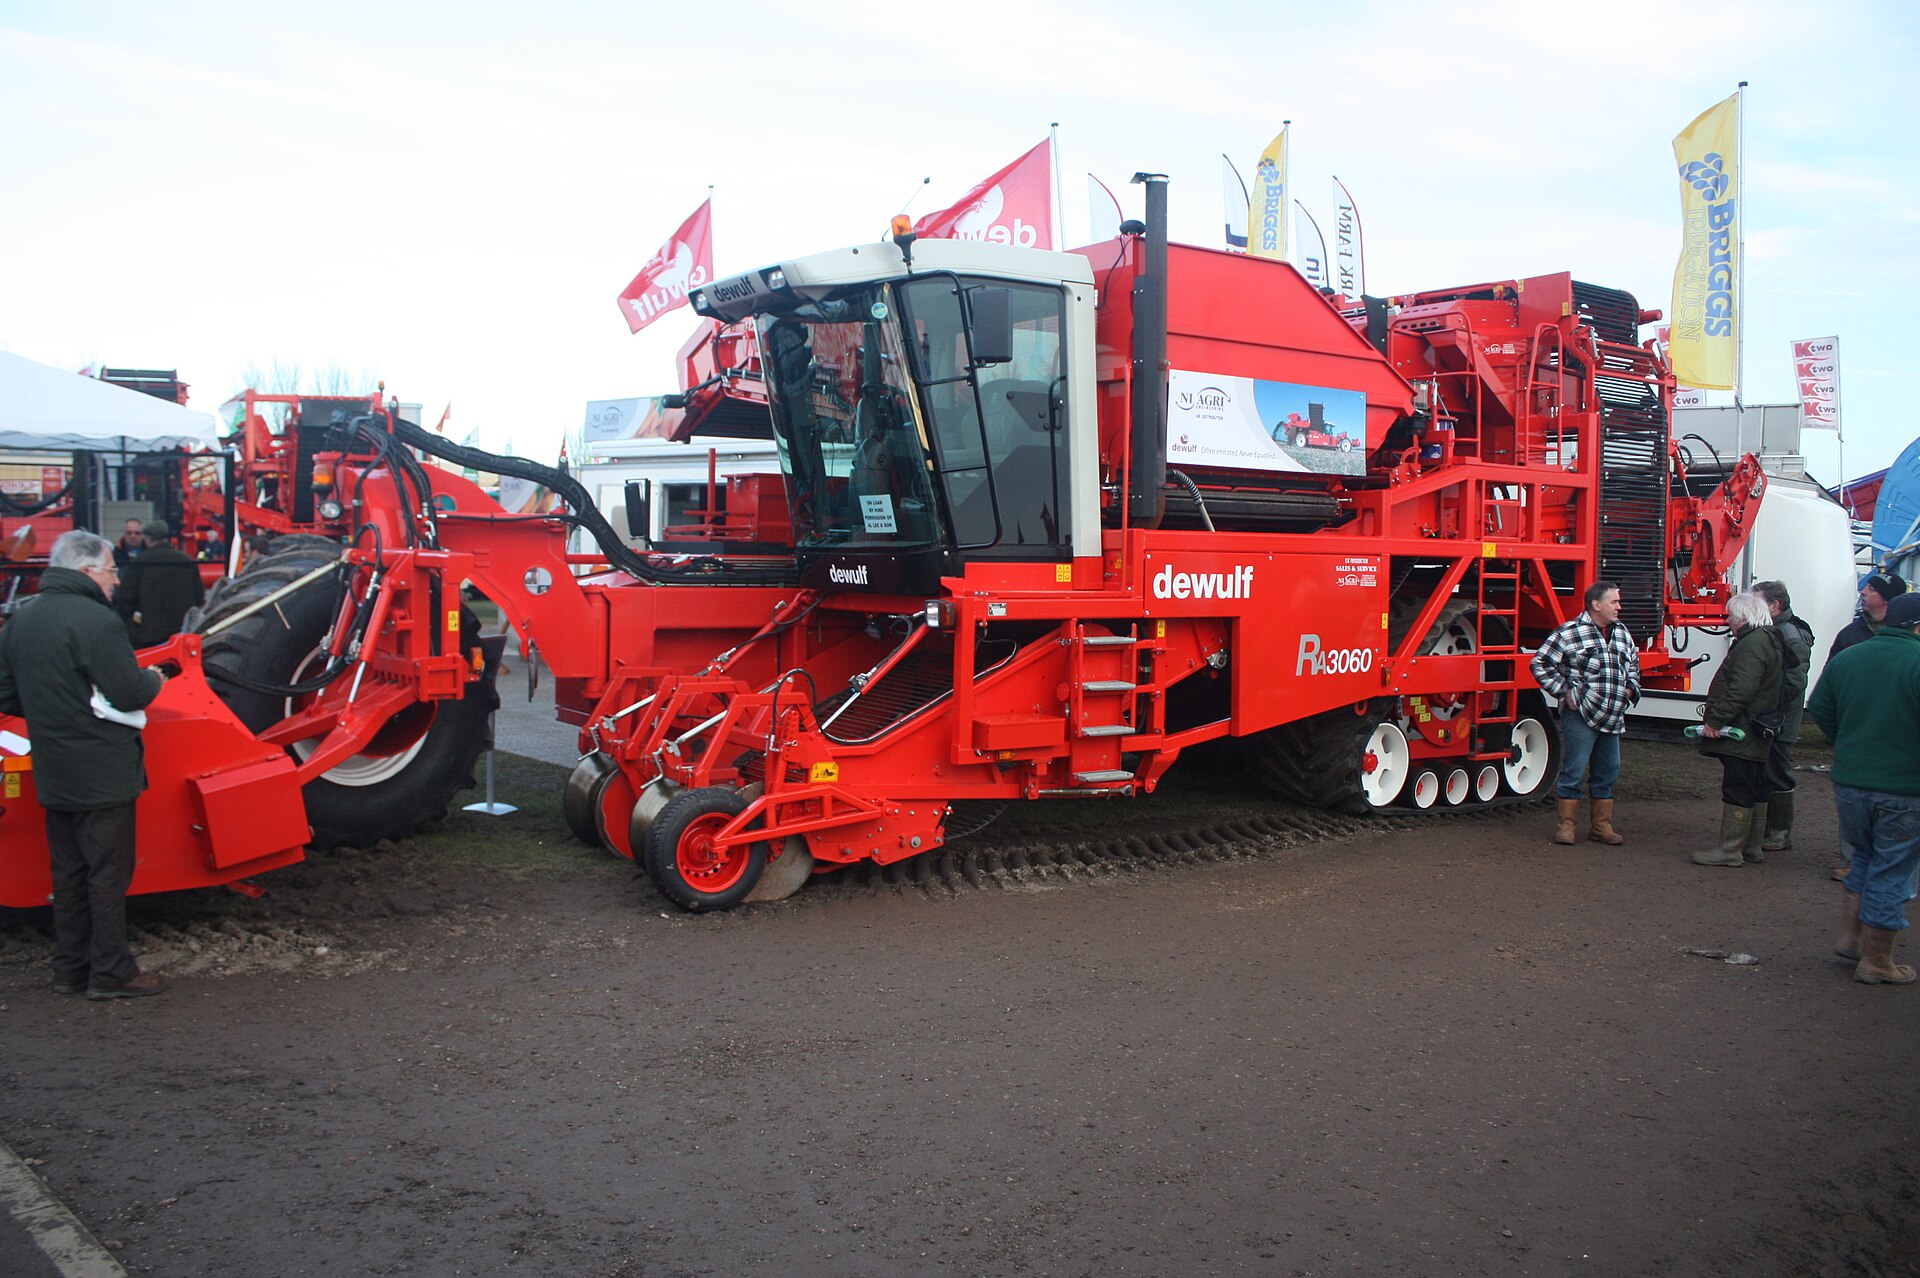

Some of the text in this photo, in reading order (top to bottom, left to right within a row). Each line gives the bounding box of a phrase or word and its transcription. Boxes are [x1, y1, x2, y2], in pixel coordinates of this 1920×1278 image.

[1263, 184, 1283, 250] BRIGGS
[1677, 206, 1708, 342] IRRIGATION
[1704, 198, 1735, 337] BRIGGS
[714, 275, 756, 303] dewulf
[1794, 341, 1833, 358] Ktwo
[1797, 362, 1834, 378] Ktwo
[1801, 382, 1835, 397] Ktwo
[1180, 392, 1224, 406] NI AGRI
[1672, 394, 1699, 407] two
[1804, 401, 1836, 417] Ktwo
[1172, 442, 1198, 454] dewulf
[829, 563, 868, 585] dewulf
[1153, 564, 1254, 599] dewulf
